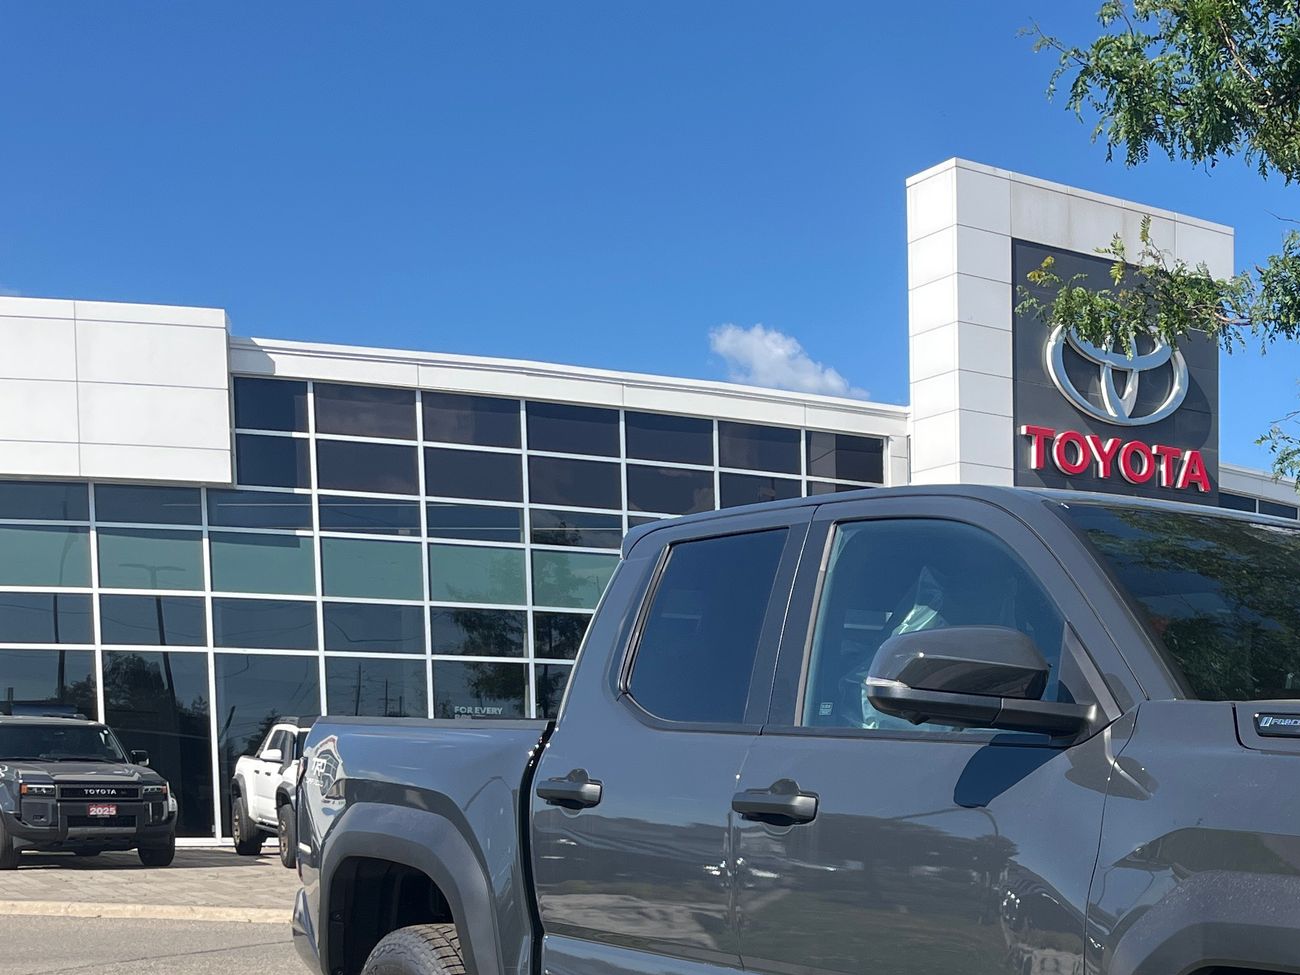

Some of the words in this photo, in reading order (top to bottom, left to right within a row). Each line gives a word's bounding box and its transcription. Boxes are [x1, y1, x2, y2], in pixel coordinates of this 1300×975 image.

[1021, 425, 1211, 493] TOYOTA
[454, 706, 473, 714] FOR
[474, 707, 503, 715] EVERY
[84, 788, 117, 796] TOYOTA
[89, 807, 116, 816] 2025
